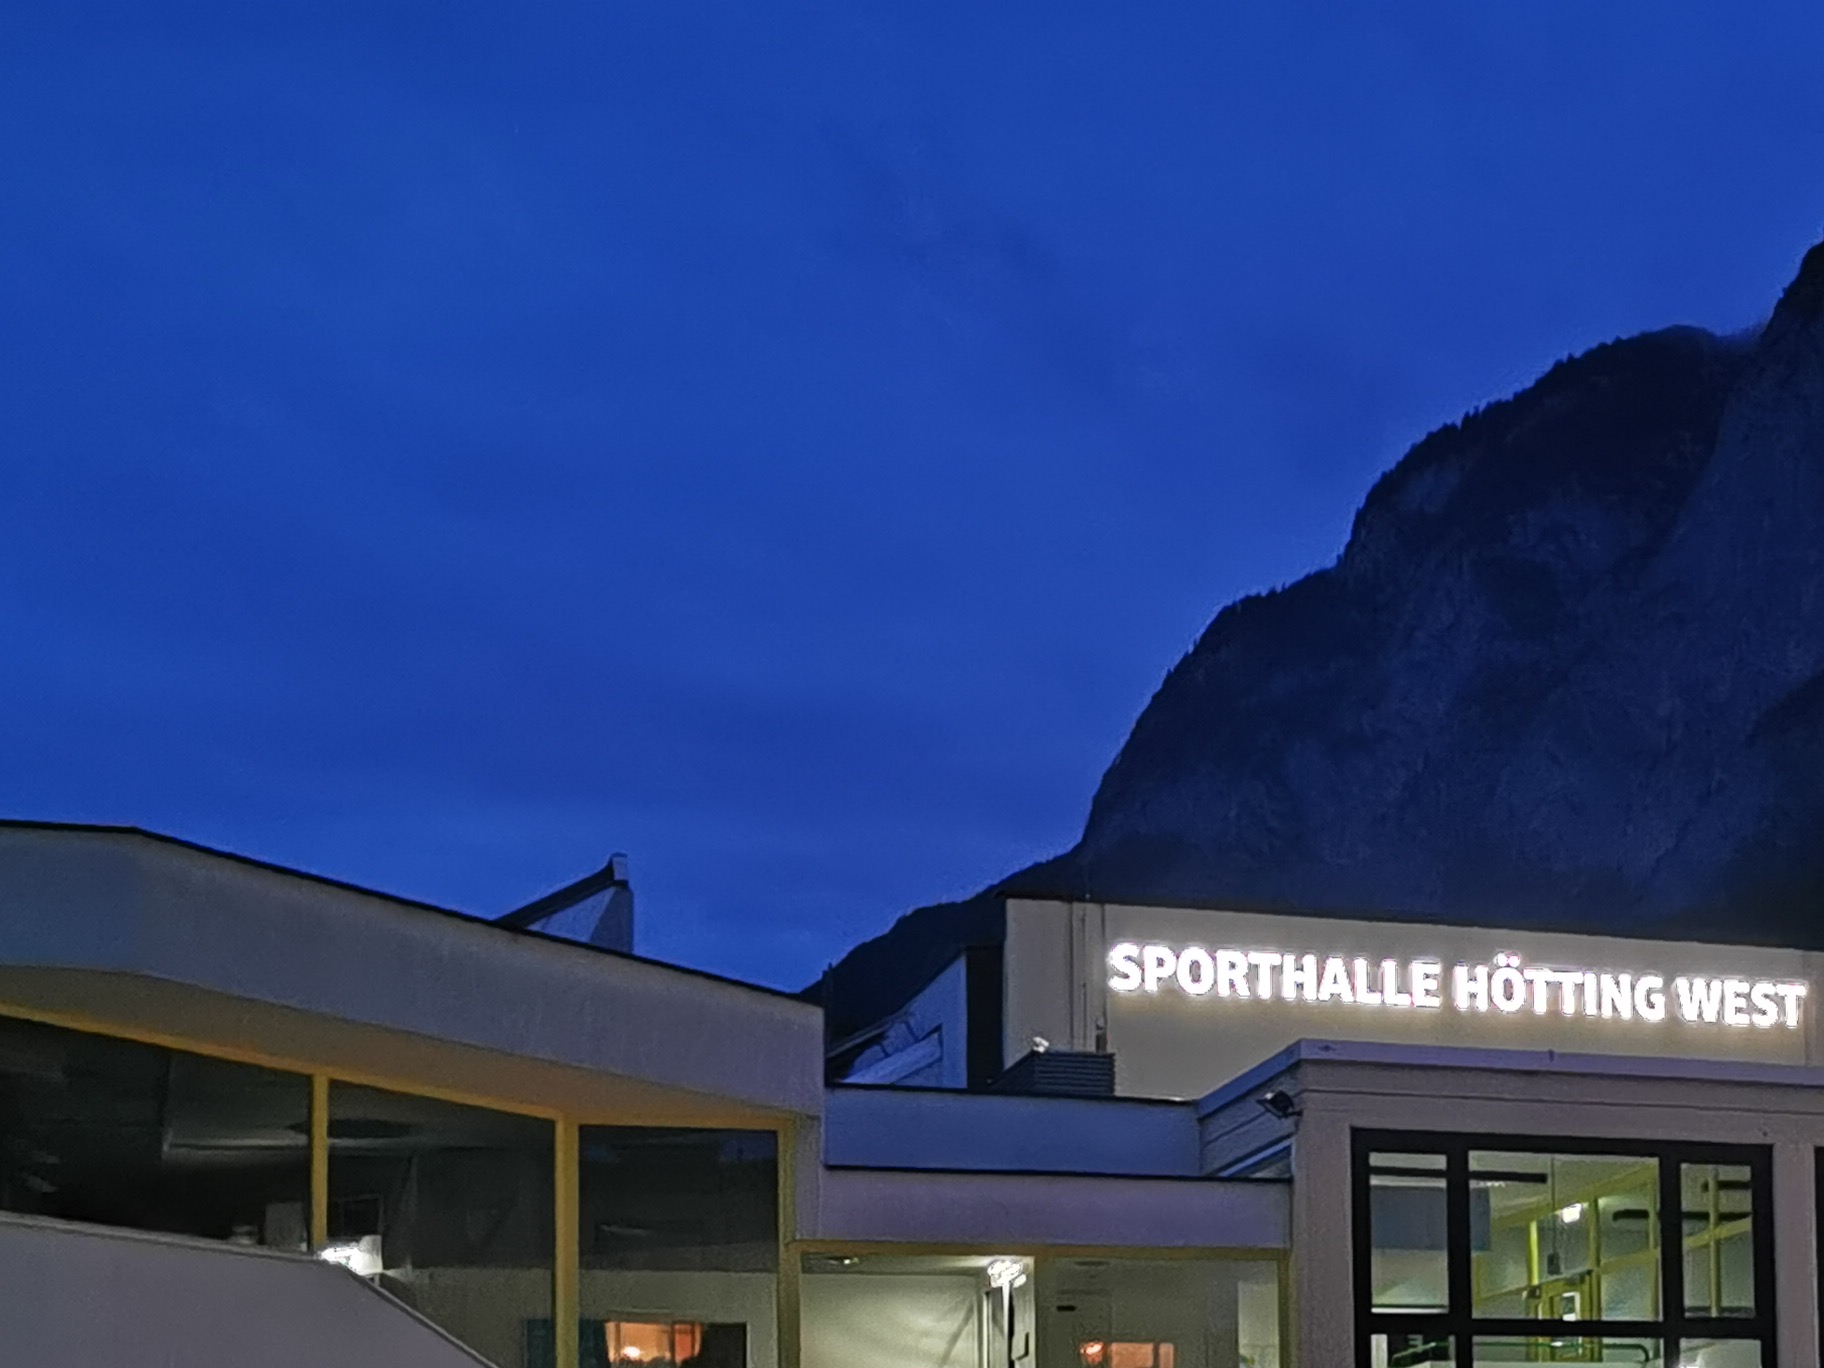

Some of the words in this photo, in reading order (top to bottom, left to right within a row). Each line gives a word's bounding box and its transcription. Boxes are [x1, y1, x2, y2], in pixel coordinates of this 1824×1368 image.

[1108, 943, 1442, 1009] SPORTHALLE
[1453, 952, 1666, 1021] HÖTTING
[1673, 975, 1807, 1027] WEST
